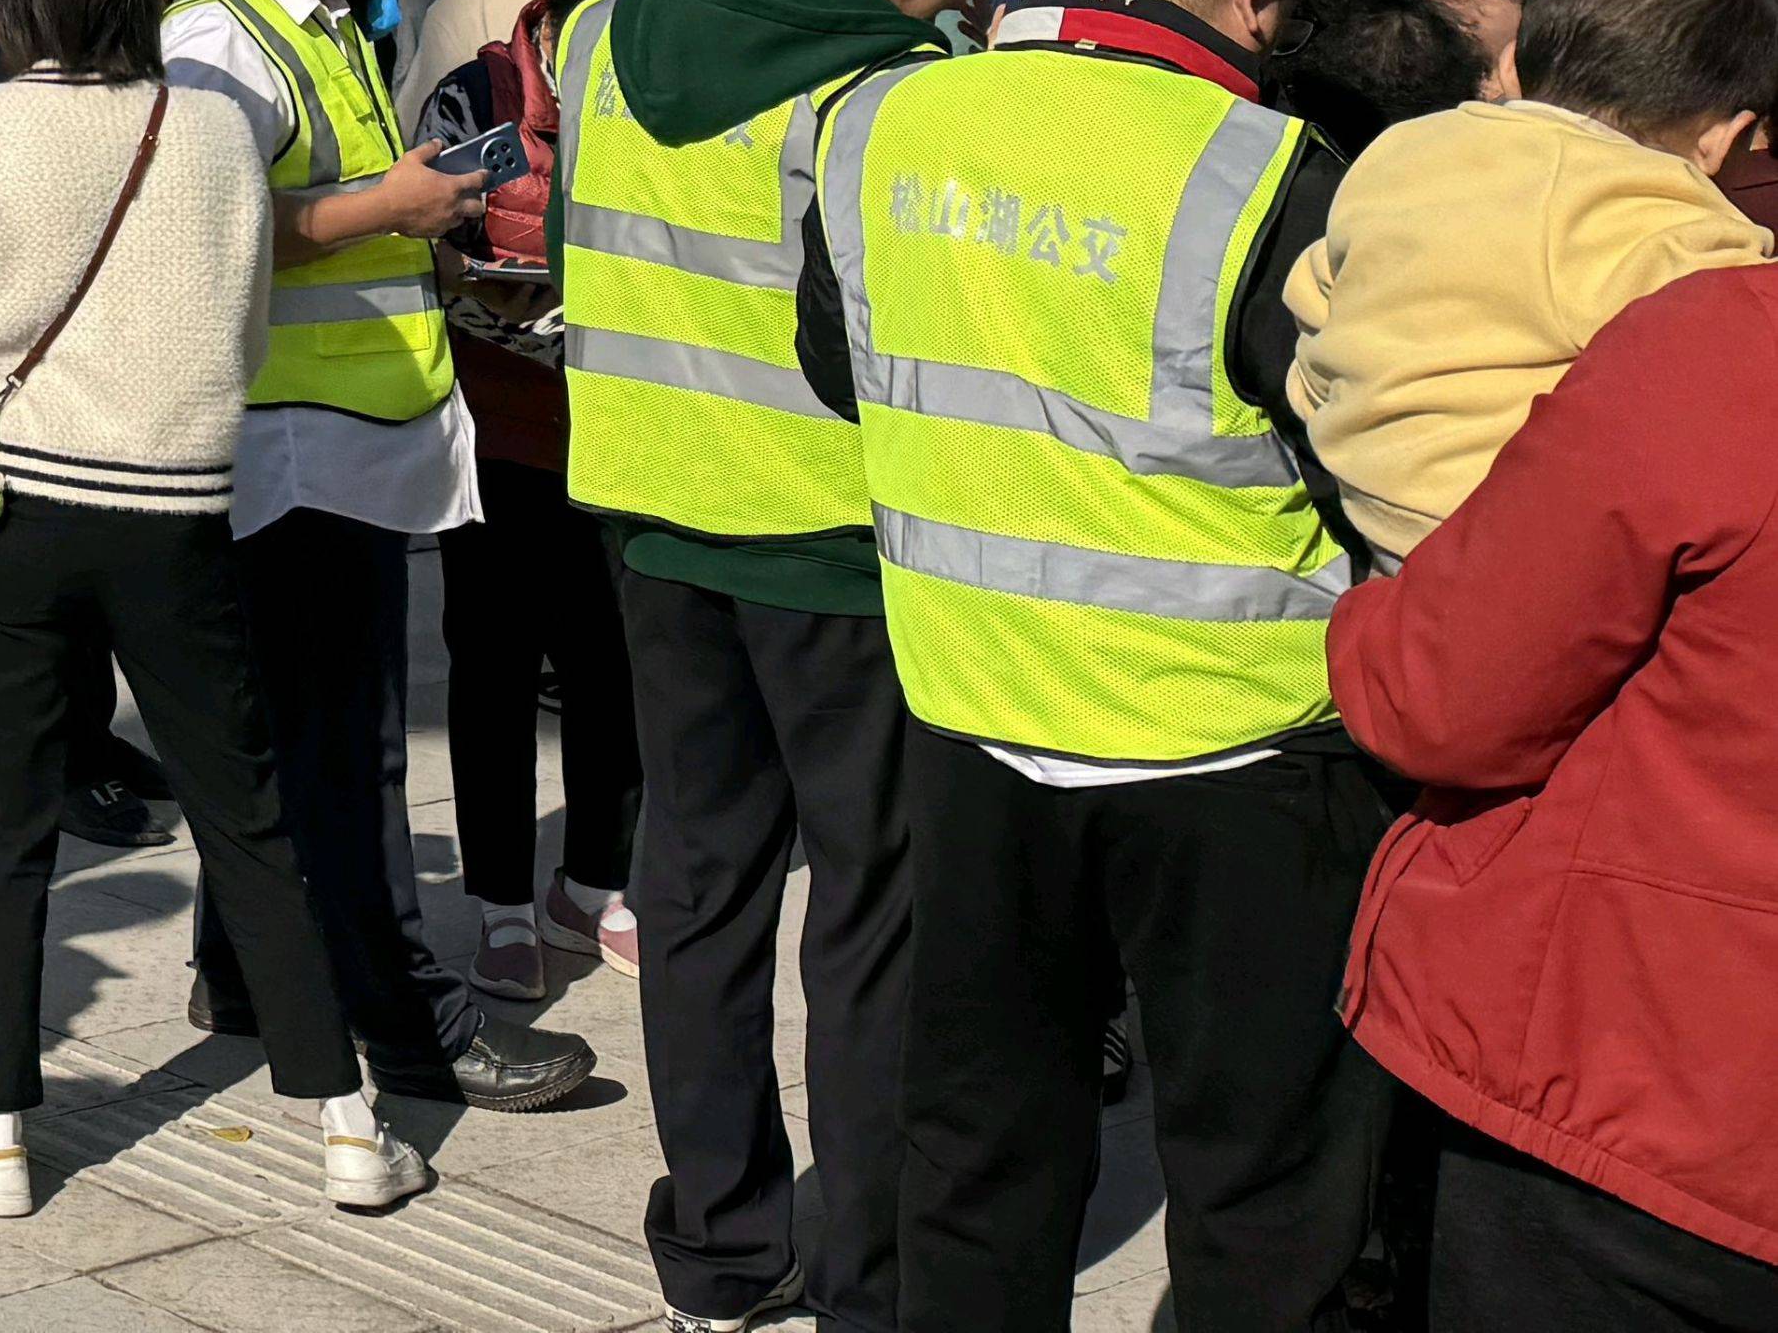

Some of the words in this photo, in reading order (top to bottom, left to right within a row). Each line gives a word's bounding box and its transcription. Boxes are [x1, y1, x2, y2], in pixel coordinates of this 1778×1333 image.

[888, 172, 1129, 286] 松山湖公交
